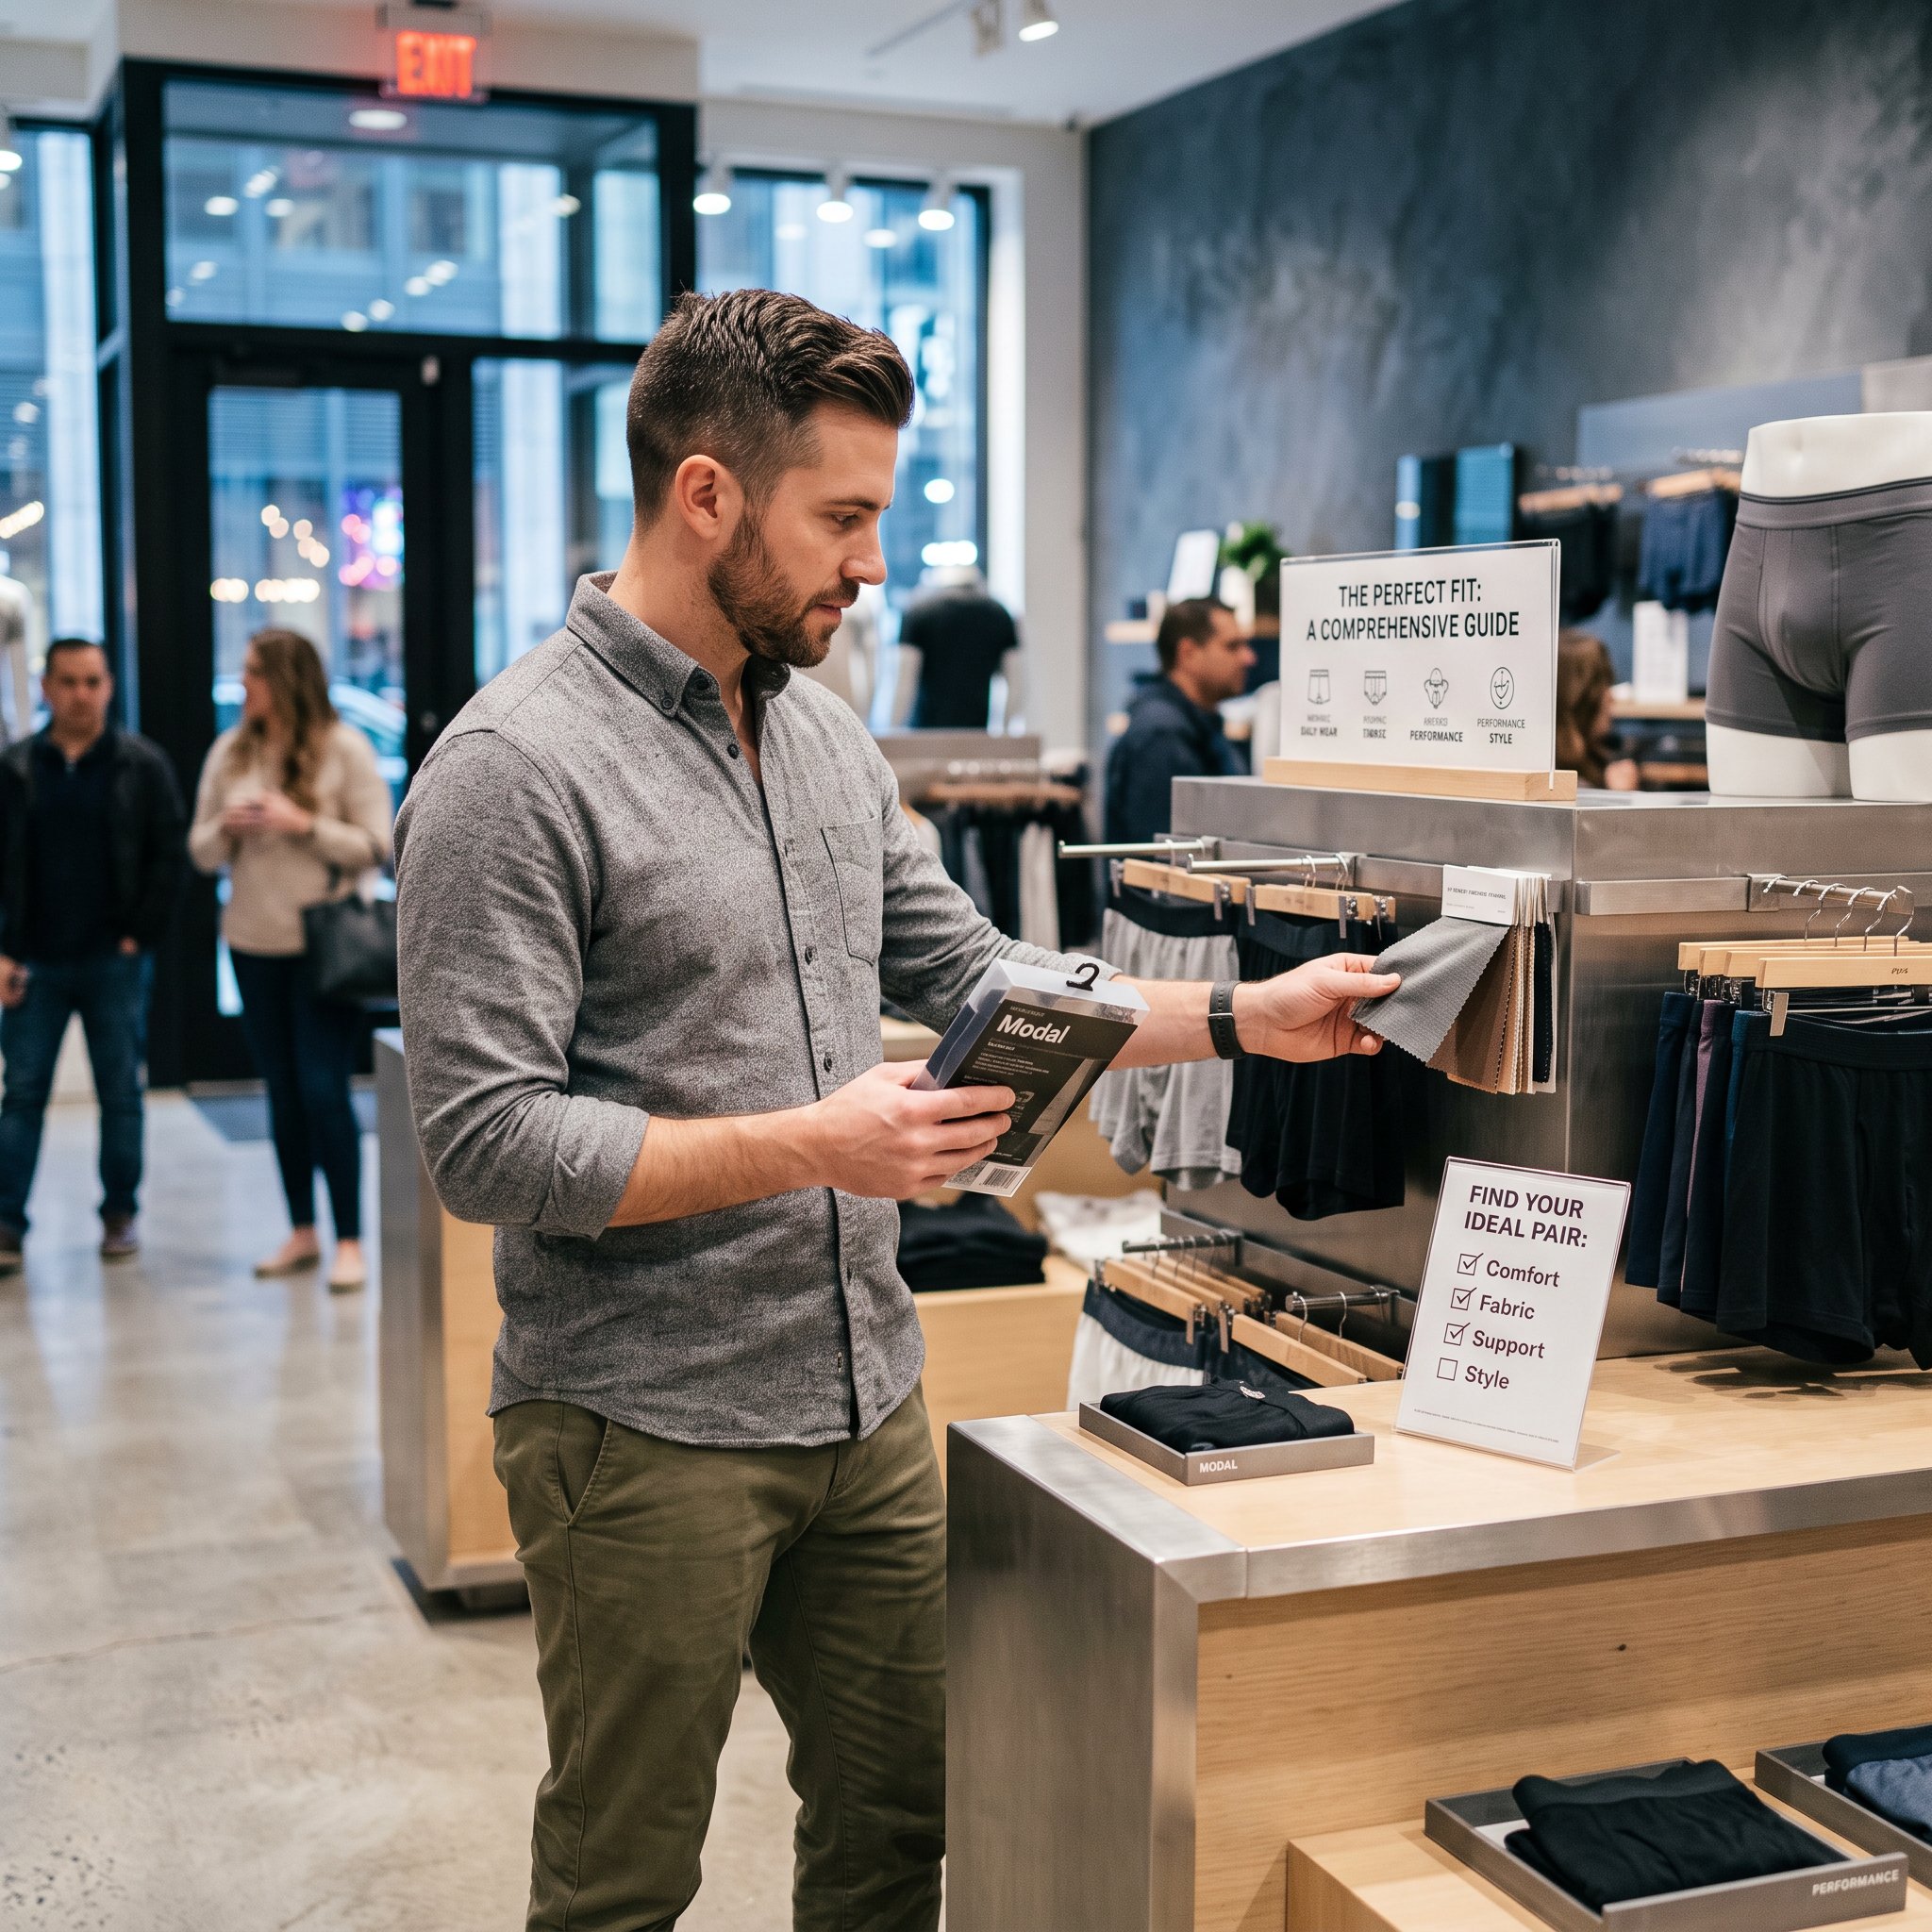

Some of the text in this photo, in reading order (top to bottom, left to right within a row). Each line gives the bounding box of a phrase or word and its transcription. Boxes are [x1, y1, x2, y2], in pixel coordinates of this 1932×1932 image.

[396, 30, 475, 98] EXIT
[1339, 578, 1481, 607] THE PERFECT FIT:
[1307, 612, 1520, 641] A COMPREHENSIVE GUIDE
[1409, 730, 1464, 742] PERFORMANCE
[1476, 718, 1525, 729] PERFORMANCE
[1489, 733, 1513, 744] STYLE
[996, 1014, 1072, 1044] Modal
[1469, 1185, 1584, 1219] FIND YOUR
[1464, 1211, 1588, 1247] IDEAL PAIR:
[1486, 1259, 1560, 1288] Comfort
[1479, 1294, 1535, 1320] Fabric
[1472, 1330, 1545, 1358] Support
[1464, 1365, 1509, 1390] Style
[1199, 1459, 1238, 1474] MODAL
[1812, 1869, 1900, 1896] PERFORMANCE
